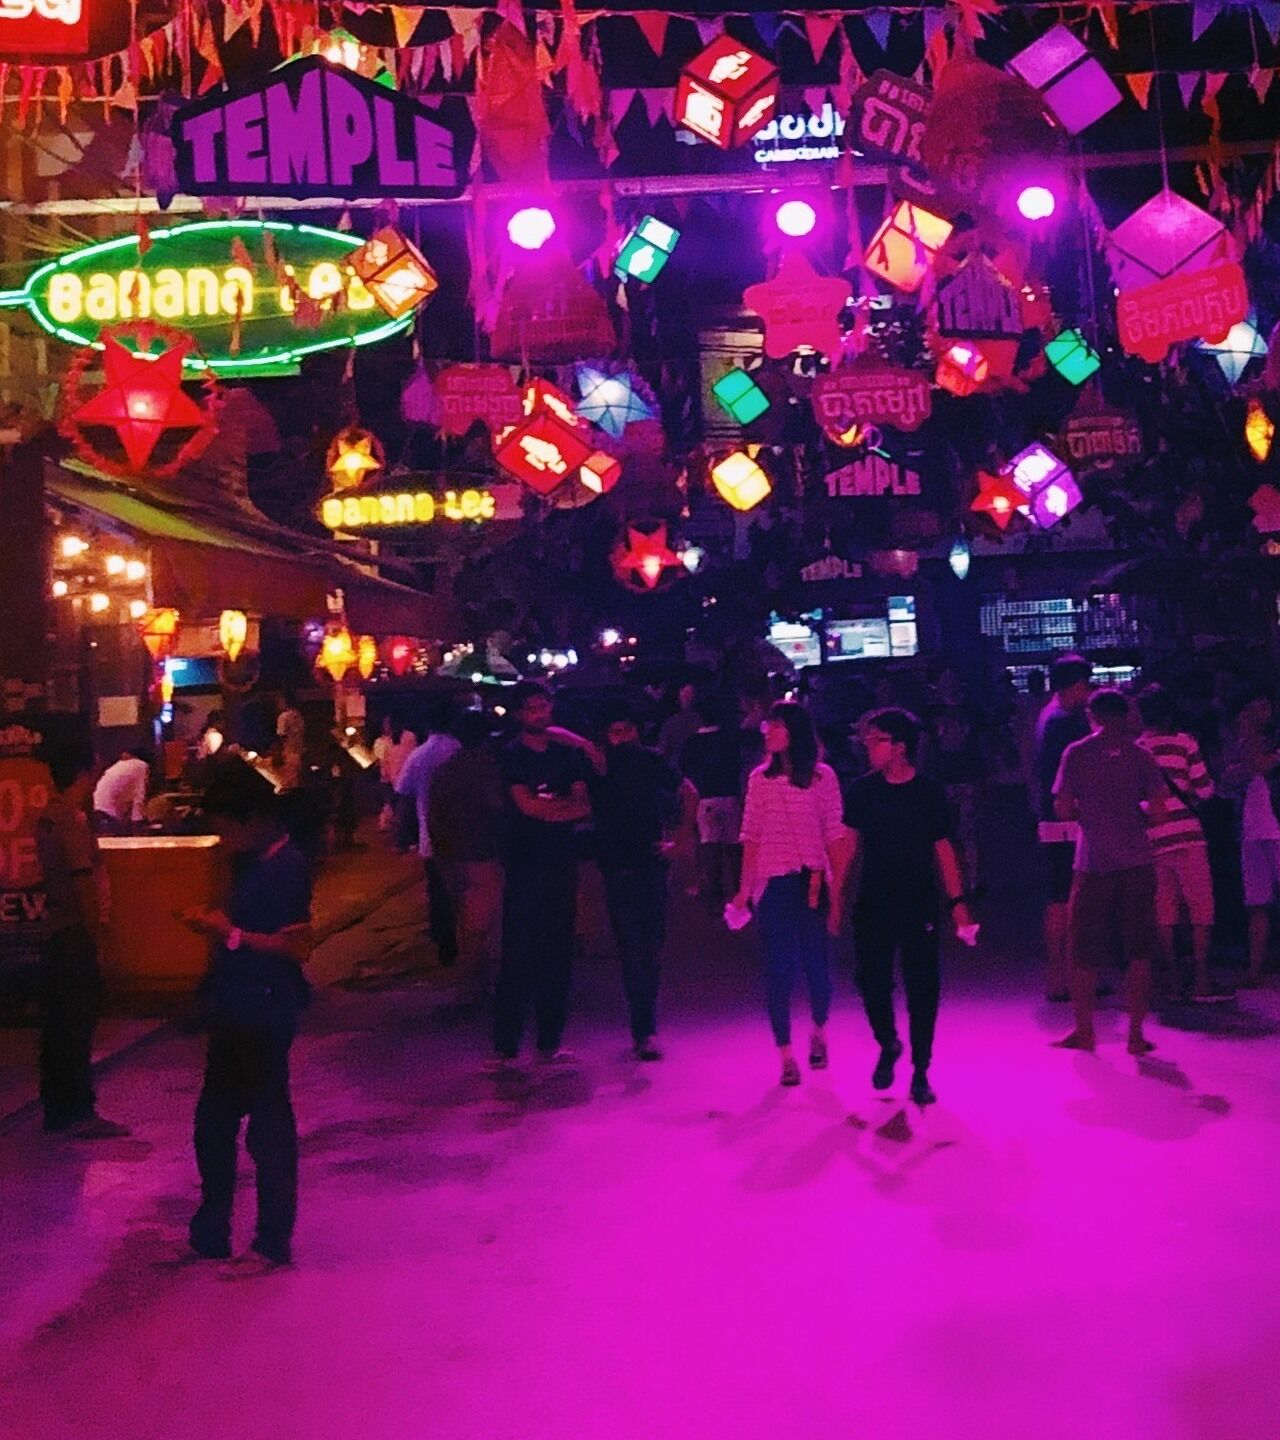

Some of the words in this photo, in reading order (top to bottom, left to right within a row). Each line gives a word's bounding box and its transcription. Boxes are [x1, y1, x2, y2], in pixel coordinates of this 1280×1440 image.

[182, 66, 457, 187] TEMPLE
[46, 266, 254, 324] Banana
[824, 455, 921, 497] TEMPLE
